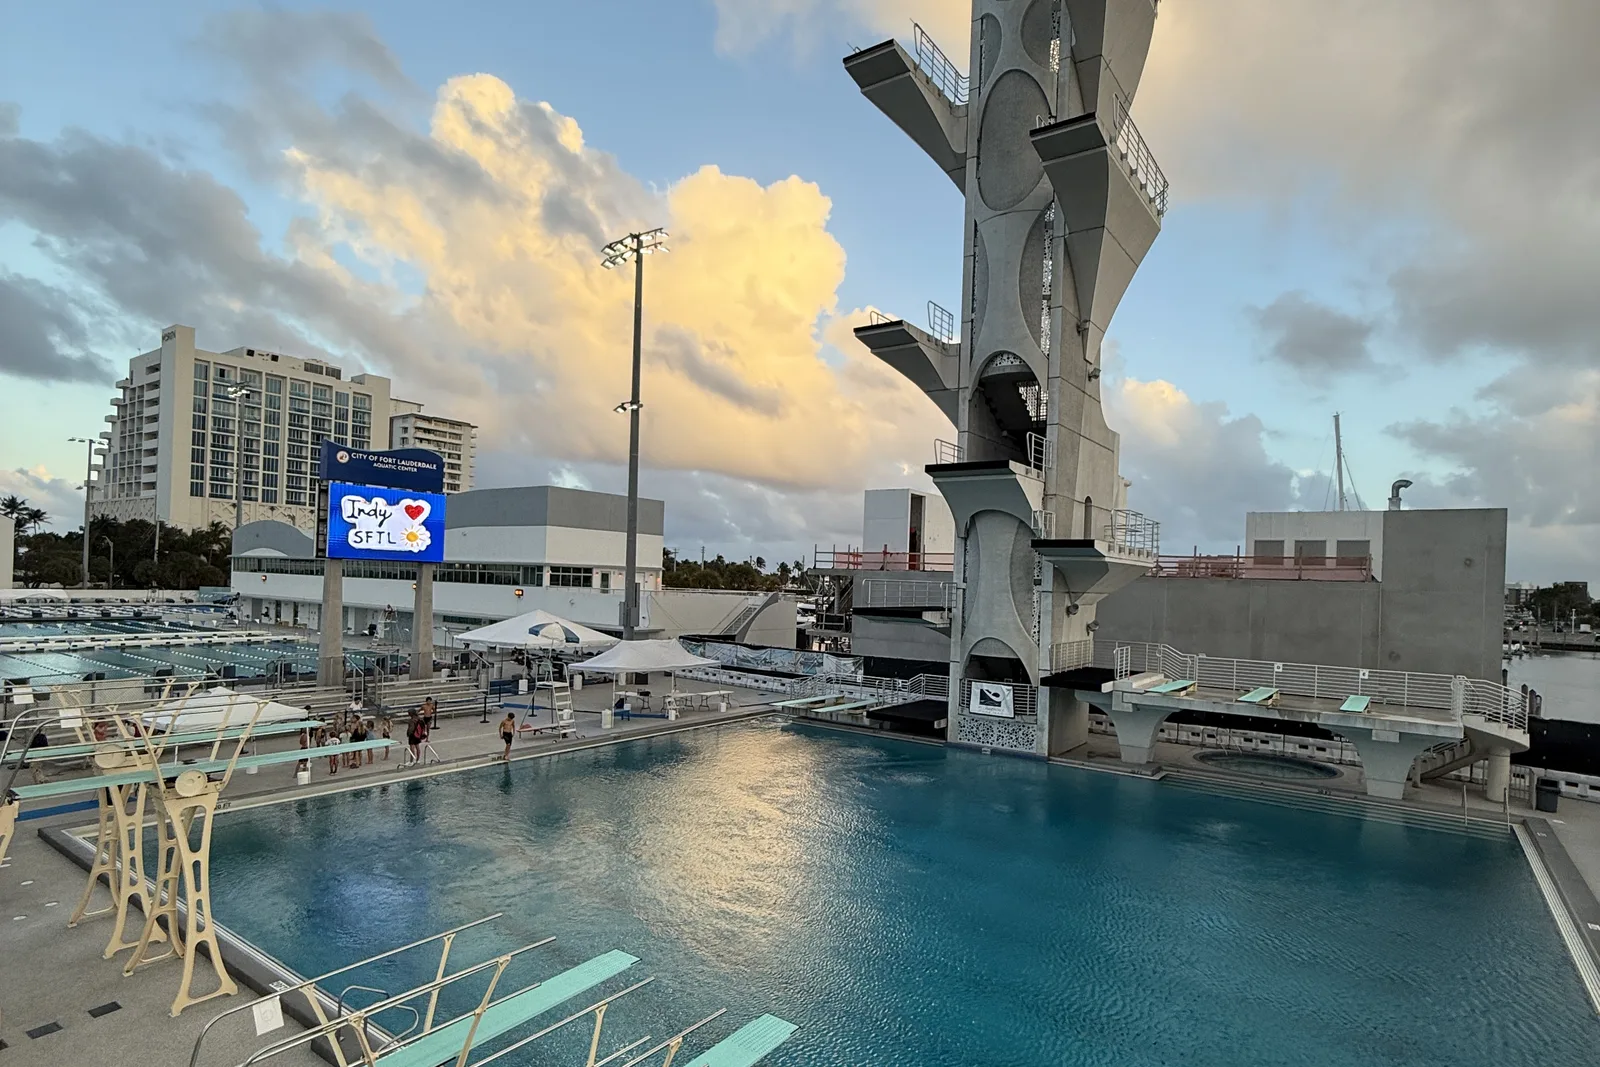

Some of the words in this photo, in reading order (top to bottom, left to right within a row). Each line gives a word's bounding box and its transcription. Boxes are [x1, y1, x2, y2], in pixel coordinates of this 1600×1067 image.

[351, 452, 367, 460] CITY
[368, 454, 378, 462] OF
[379, 456, 396, 464] FORT
[397, 458, 437, 470] LAUDERDALE
[373, 462, 396, 470] AQUATIC
[346, 499, 392, 528] Indy
[353, 530, 396, 544] SFTL
